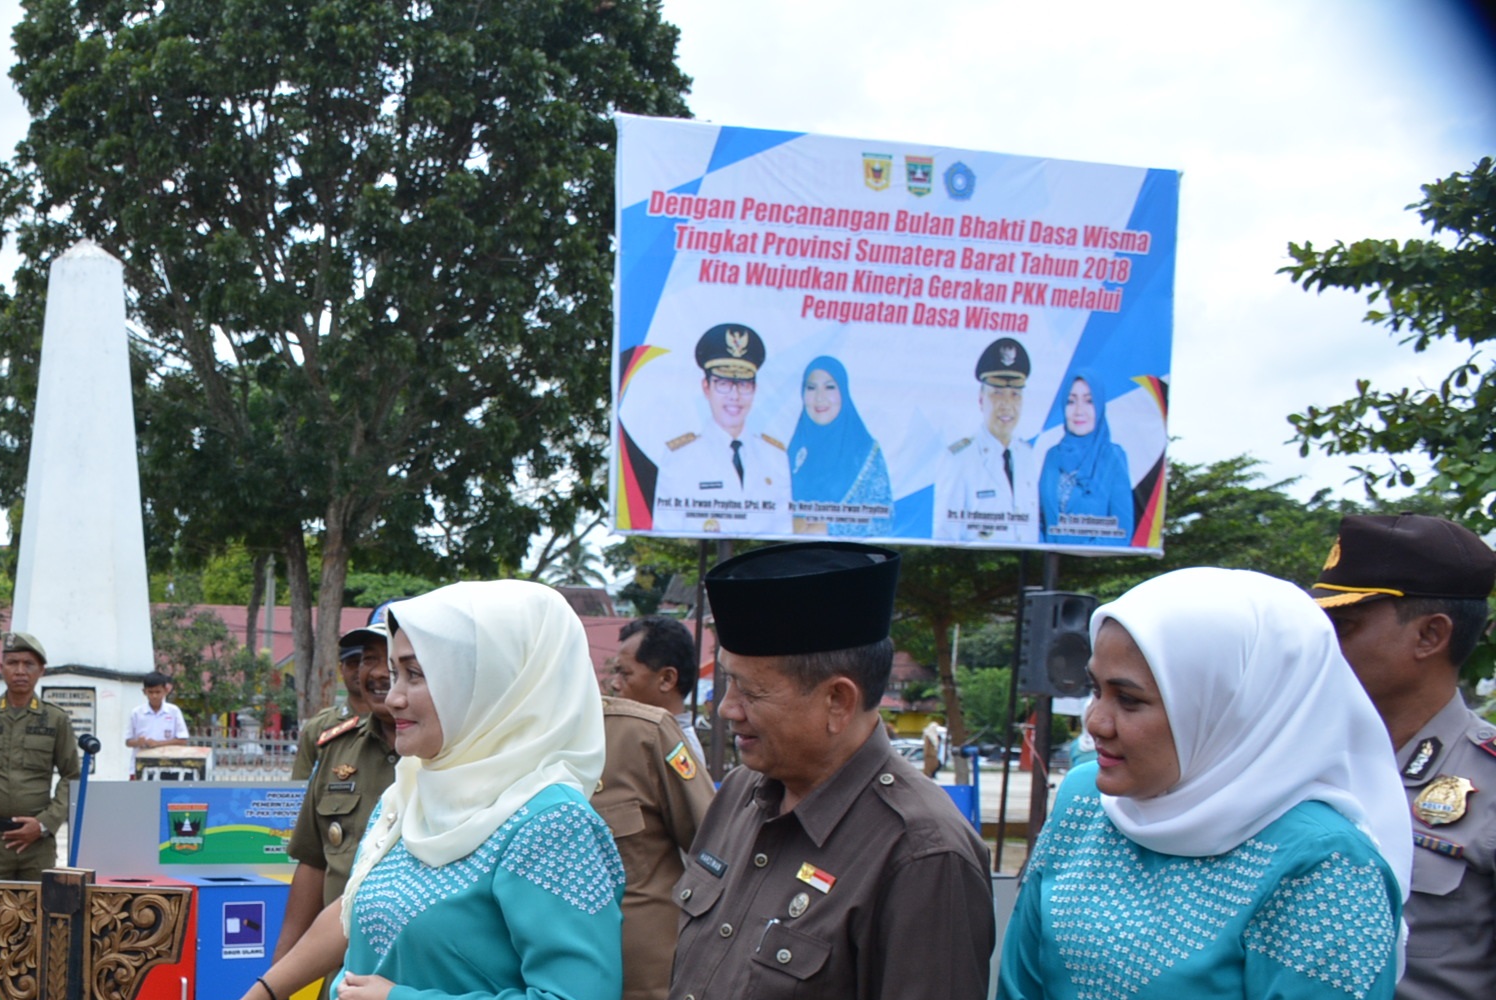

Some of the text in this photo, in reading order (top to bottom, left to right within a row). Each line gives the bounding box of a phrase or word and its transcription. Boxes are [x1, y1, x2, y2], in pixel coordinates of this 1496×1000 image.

[649, 190, 1150, 253] Dengan Pencanangan Bulan Bhakti Dasa Wisma
[675, 226, 1130, 283] Tingkat Provinsi Sumatera Barat Tahun 2018
[698, 259, 1122, 312] Kita Wujudkan Kinerja Gerakan PKK melalui
[802, 295, 1030, 332] Penguatan Dasa Wisma
